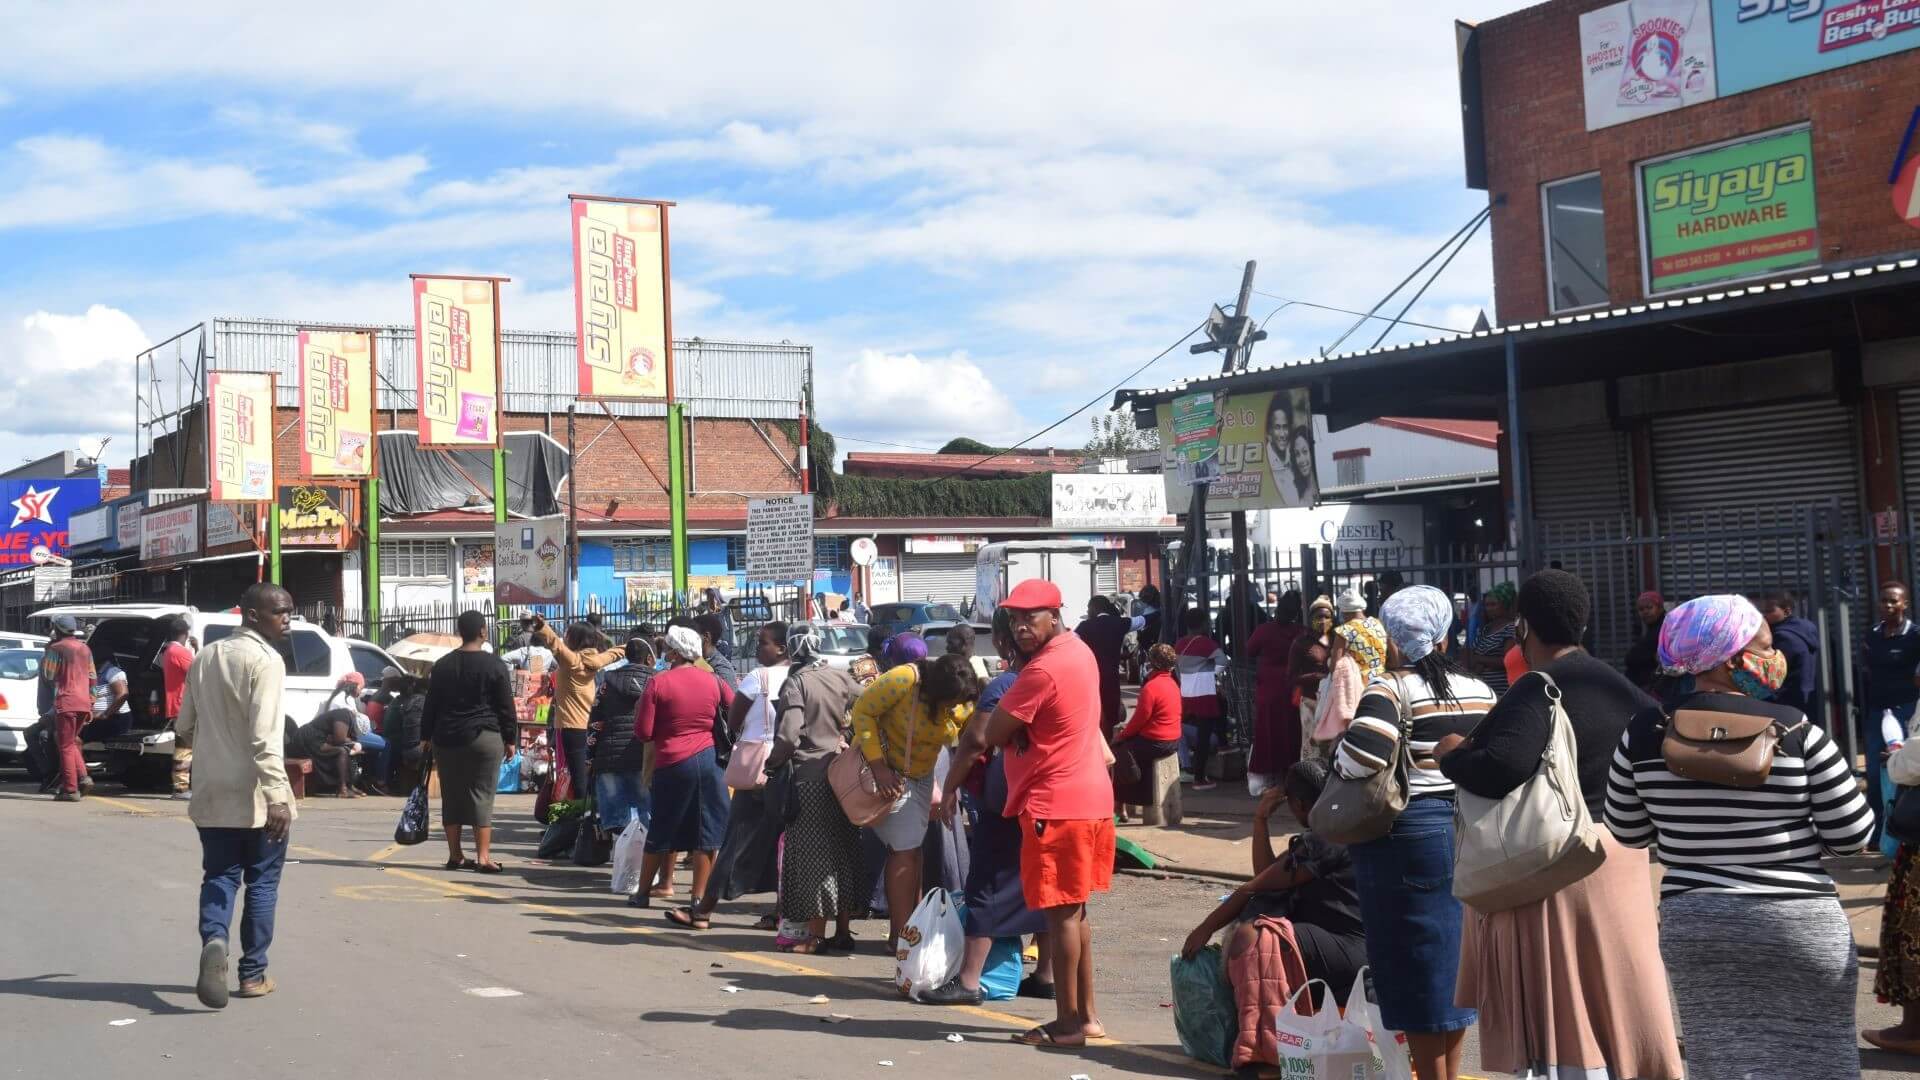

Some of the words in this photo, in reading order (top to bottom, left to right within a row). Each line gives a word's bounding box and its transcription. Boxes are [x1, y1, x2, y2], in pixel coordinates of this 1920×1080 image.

[1826, 4, 1867, 26] Cash
[1632, 17, 1685, 39] SPOOKIES
[1824, 18, 1876, 45] Best
[1653, 154, 1806, 215] Siyaya
[1677, 202, 1789, 239] HARDWARE
[586, 227, 617, 363] Siyaya
[426, 301, 452, 417] Siyaya
[307, 351, 331, 452] Siyaya
[1240, 408, 1256, 427] to
[1166, 442, 1264, 474] Sya
[766, 497, 793, 505] NOTICE
[1209, 485, 1233, 496] Best
[1238, 483, 1261, 496] Buy
[19, 492, 52, 522] SY
[1320, 519, 1394, 542] CHESTER
[1276, 1030, 1304, 1047] SPAR
[1288, 1056, 1315, 1075] 100%
